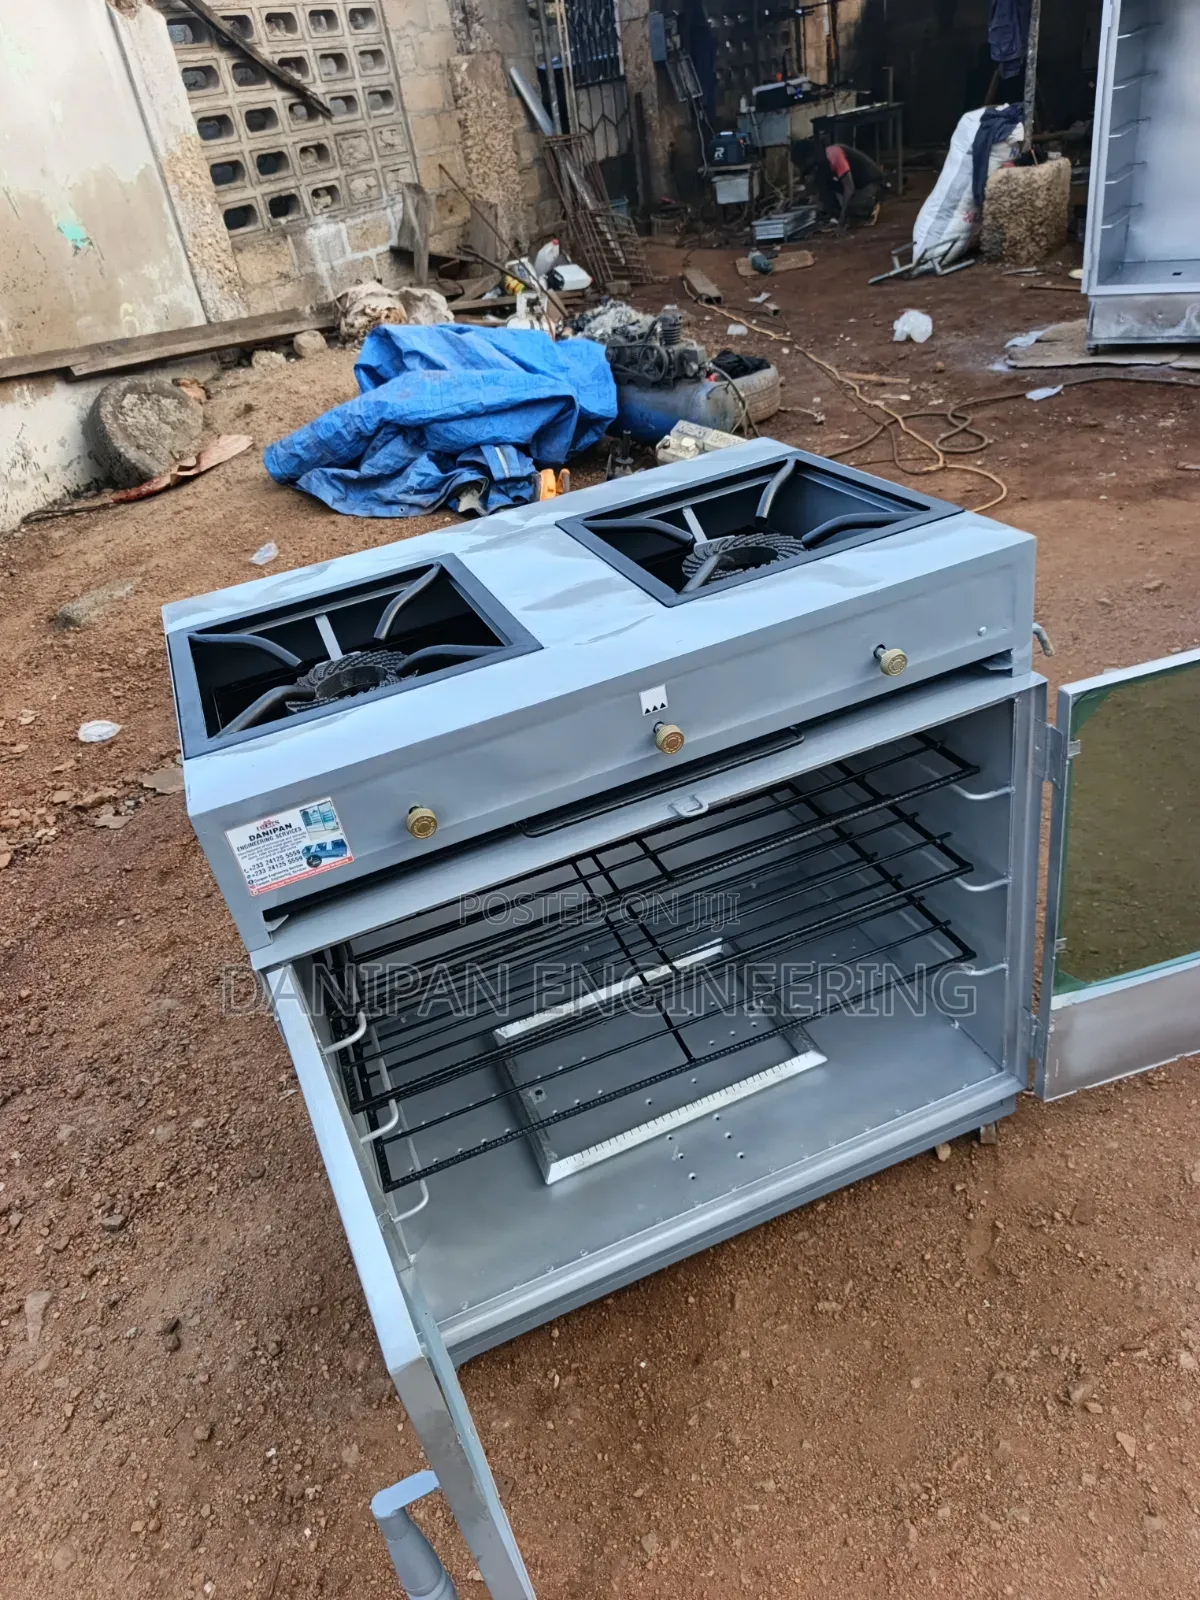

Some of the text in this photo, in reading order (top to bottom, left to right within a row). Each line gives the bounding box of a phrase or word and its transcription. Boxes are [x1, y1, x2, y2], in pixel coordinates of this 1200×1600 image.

[236, 836, 274, 852] ENGINEERING
[276, 826, 302, 839] SERVICES
[248, 823, 292, 841] DANIPAN
